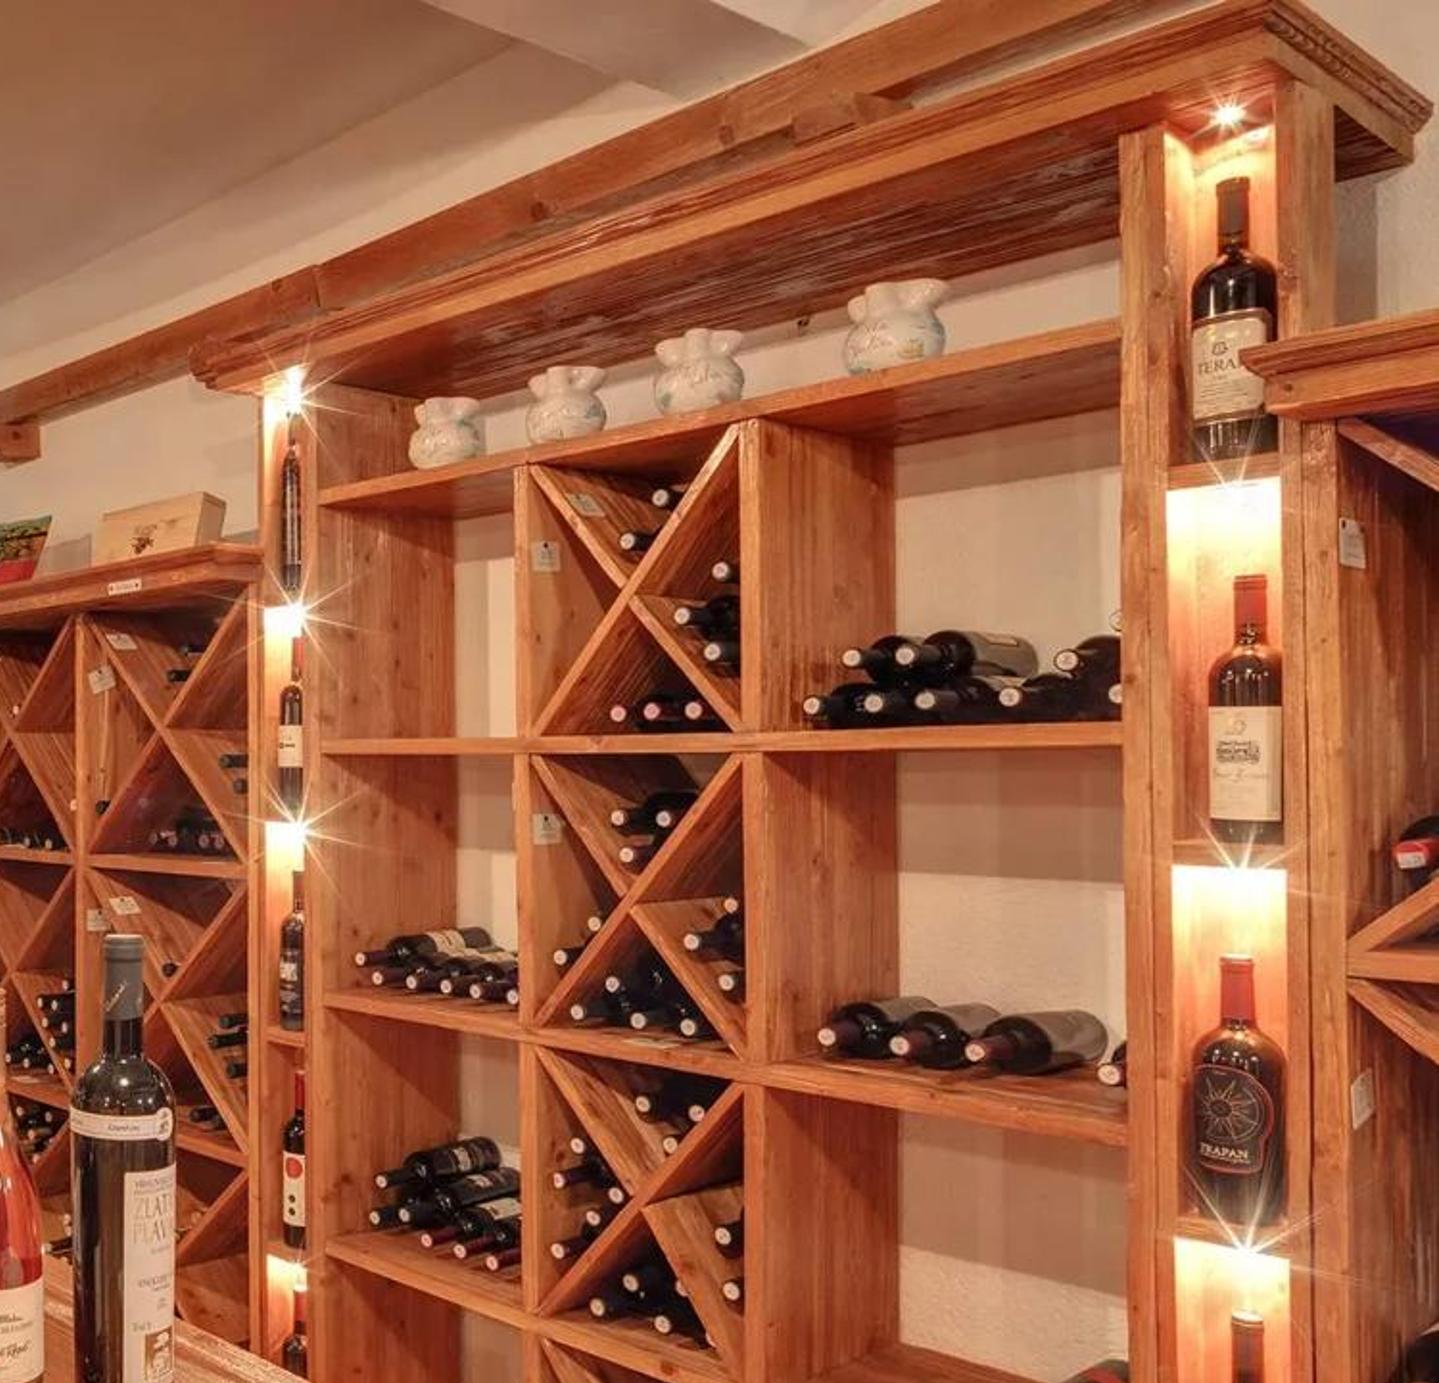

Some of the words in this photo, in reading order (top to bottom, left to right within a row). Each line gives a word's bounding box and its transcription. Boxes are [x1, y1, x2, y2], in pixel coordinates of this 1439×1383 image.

[1198, 359, 1238, 375] TERA
[1200, 1142, 1249, 1158] TRAPAN
[134, 1194, 172, 1220] ZLAT
[134, 1220, 170, 1245] PLAV
